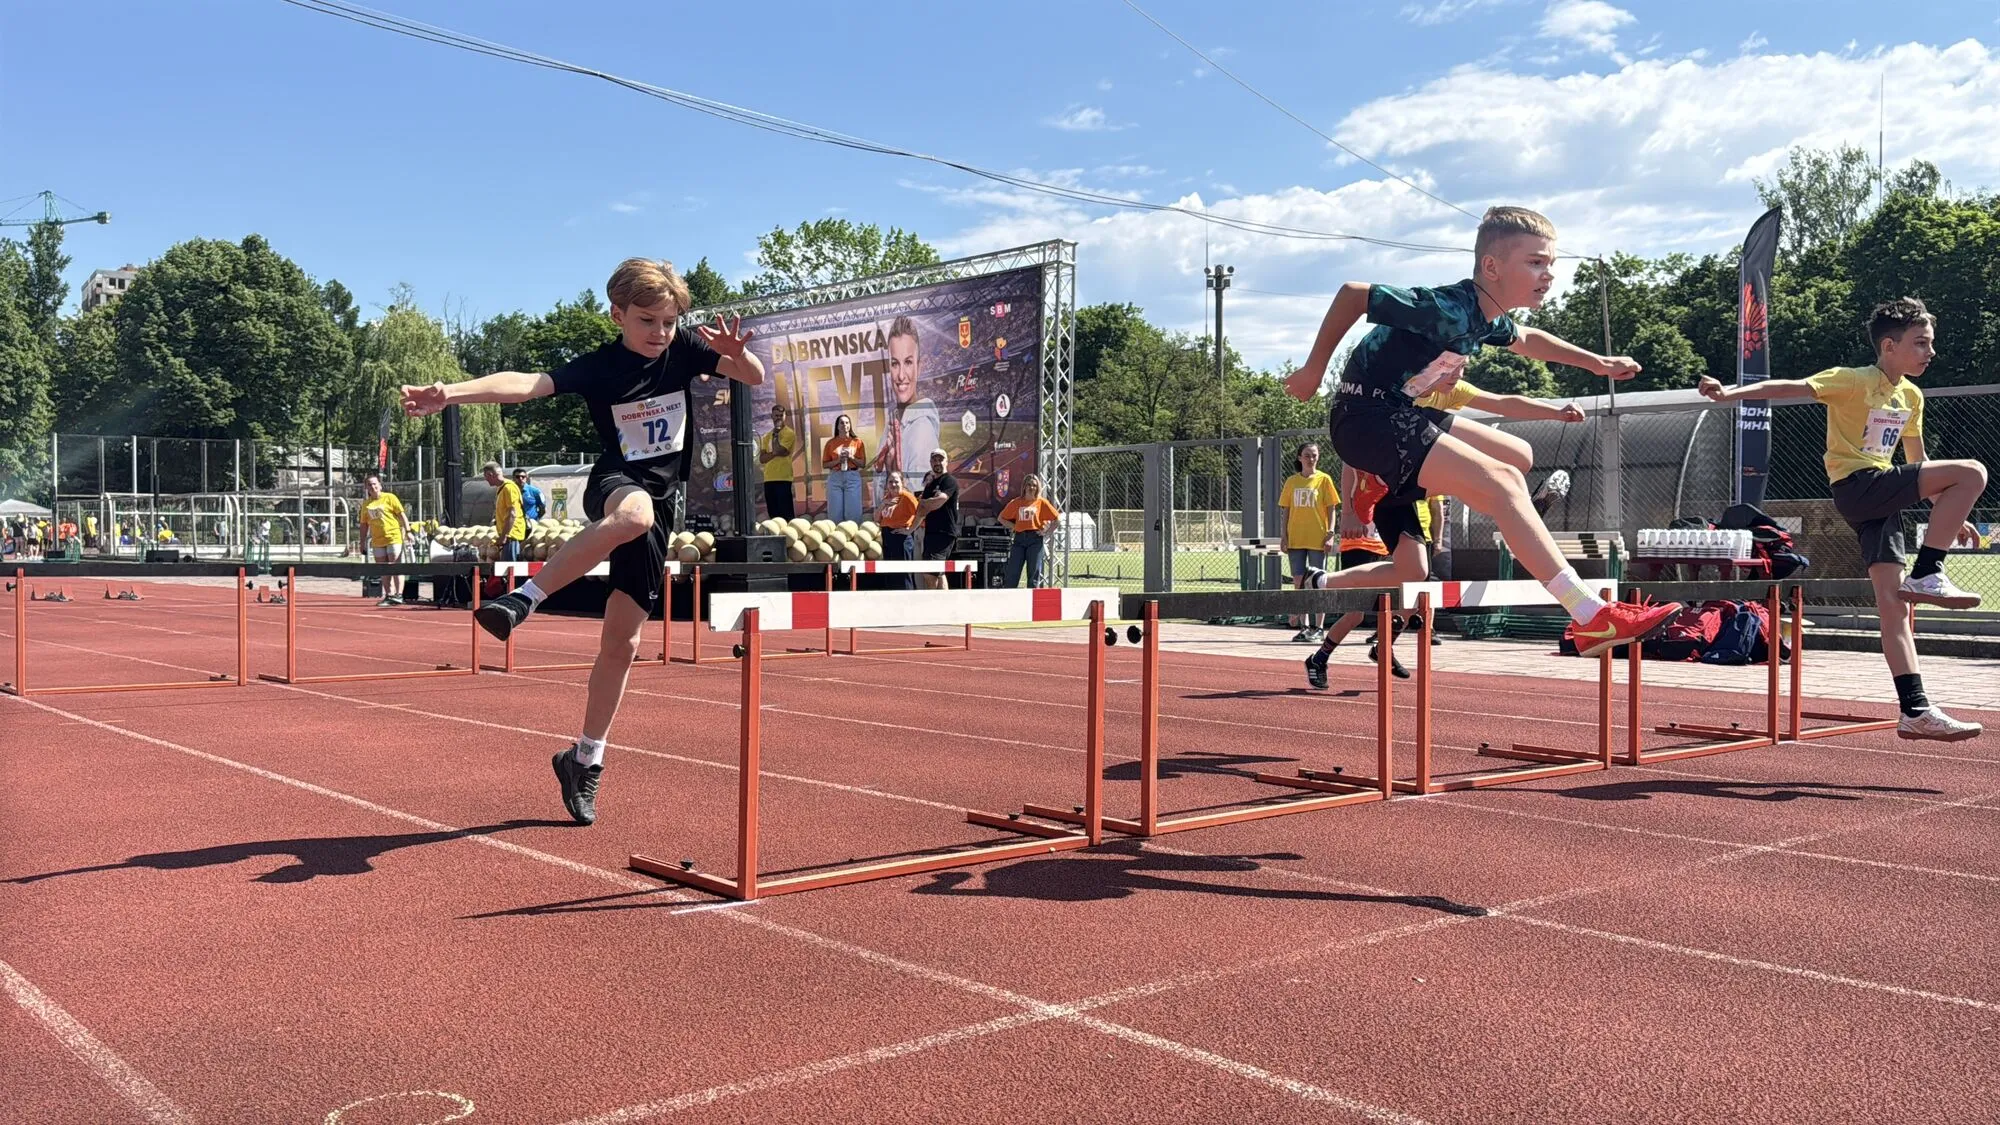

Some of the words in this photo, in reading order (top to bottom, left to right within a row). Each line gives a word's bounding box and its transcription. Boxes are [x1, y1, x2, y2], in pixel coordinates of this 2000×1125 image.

[989, 303, 1012, 316] SBM
[772, 328, 889, 364] DOBRYNSKA
[621, 407, 666, 421] DOBRYNSKA
[666, 402, 682, 412] NEXT
[642, 418, 671, 445] 72
[1882, 427, 1899, 446] 66
[1294, 487, 1318, 508] NEXT
